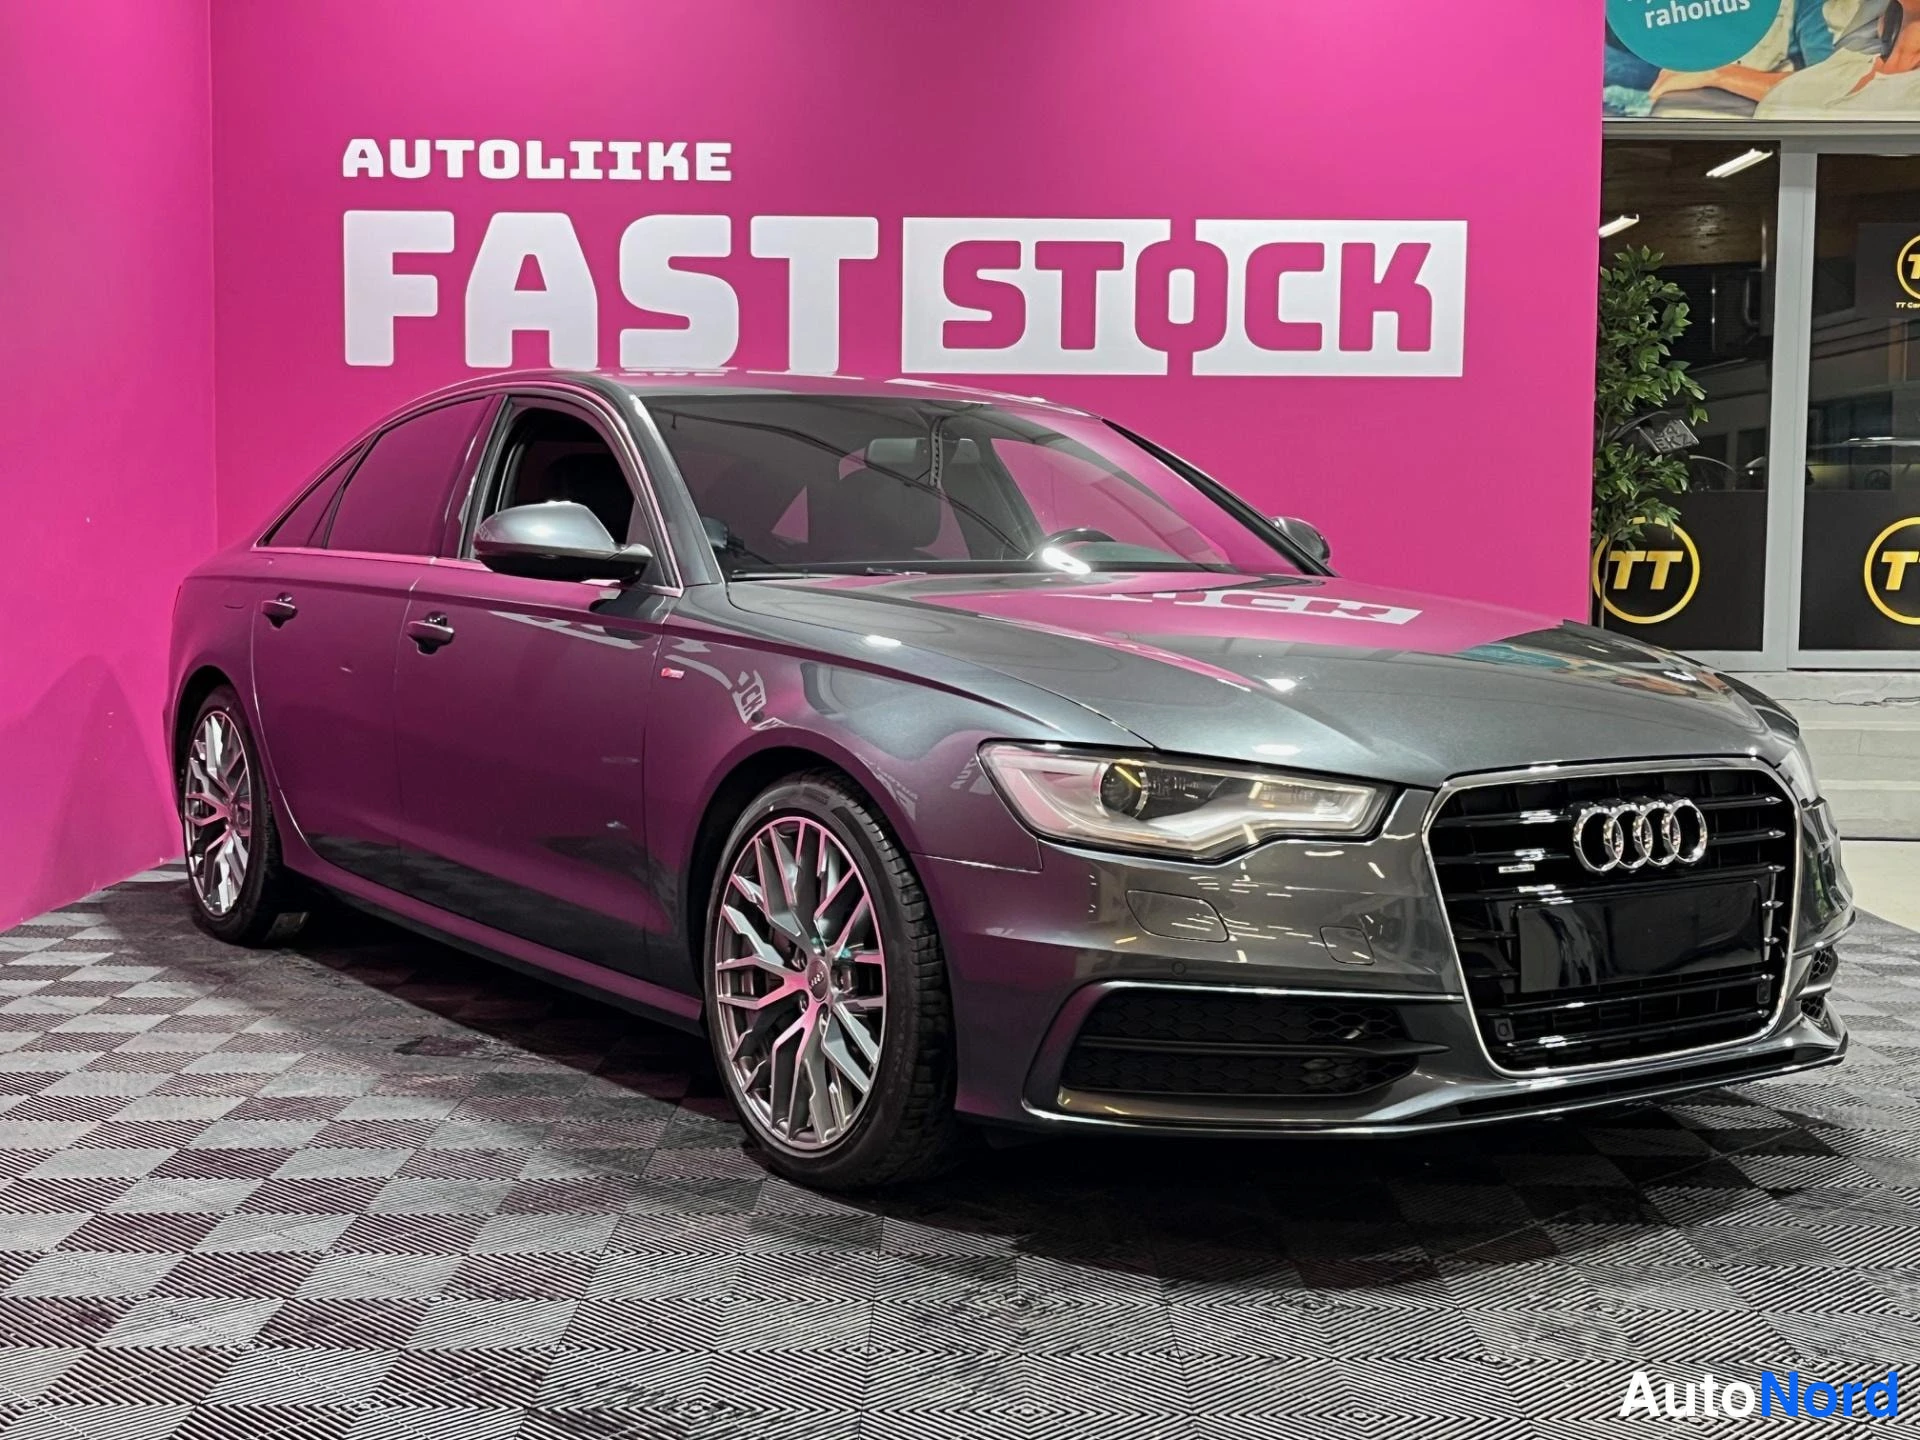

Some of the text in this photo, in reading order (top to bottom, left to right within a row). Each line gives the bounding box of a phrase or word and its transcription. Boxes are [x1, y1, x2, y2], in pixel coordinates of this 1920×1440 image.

[1644, 0, 1750, 28] rahoitus
[343, 138, 732, 181] AUTOLIIKE
[343, 210, 1433, 372] FAST STOCK
[1608, 550, 1684, 590] TT
[1881, 551, 1920, 590] T
